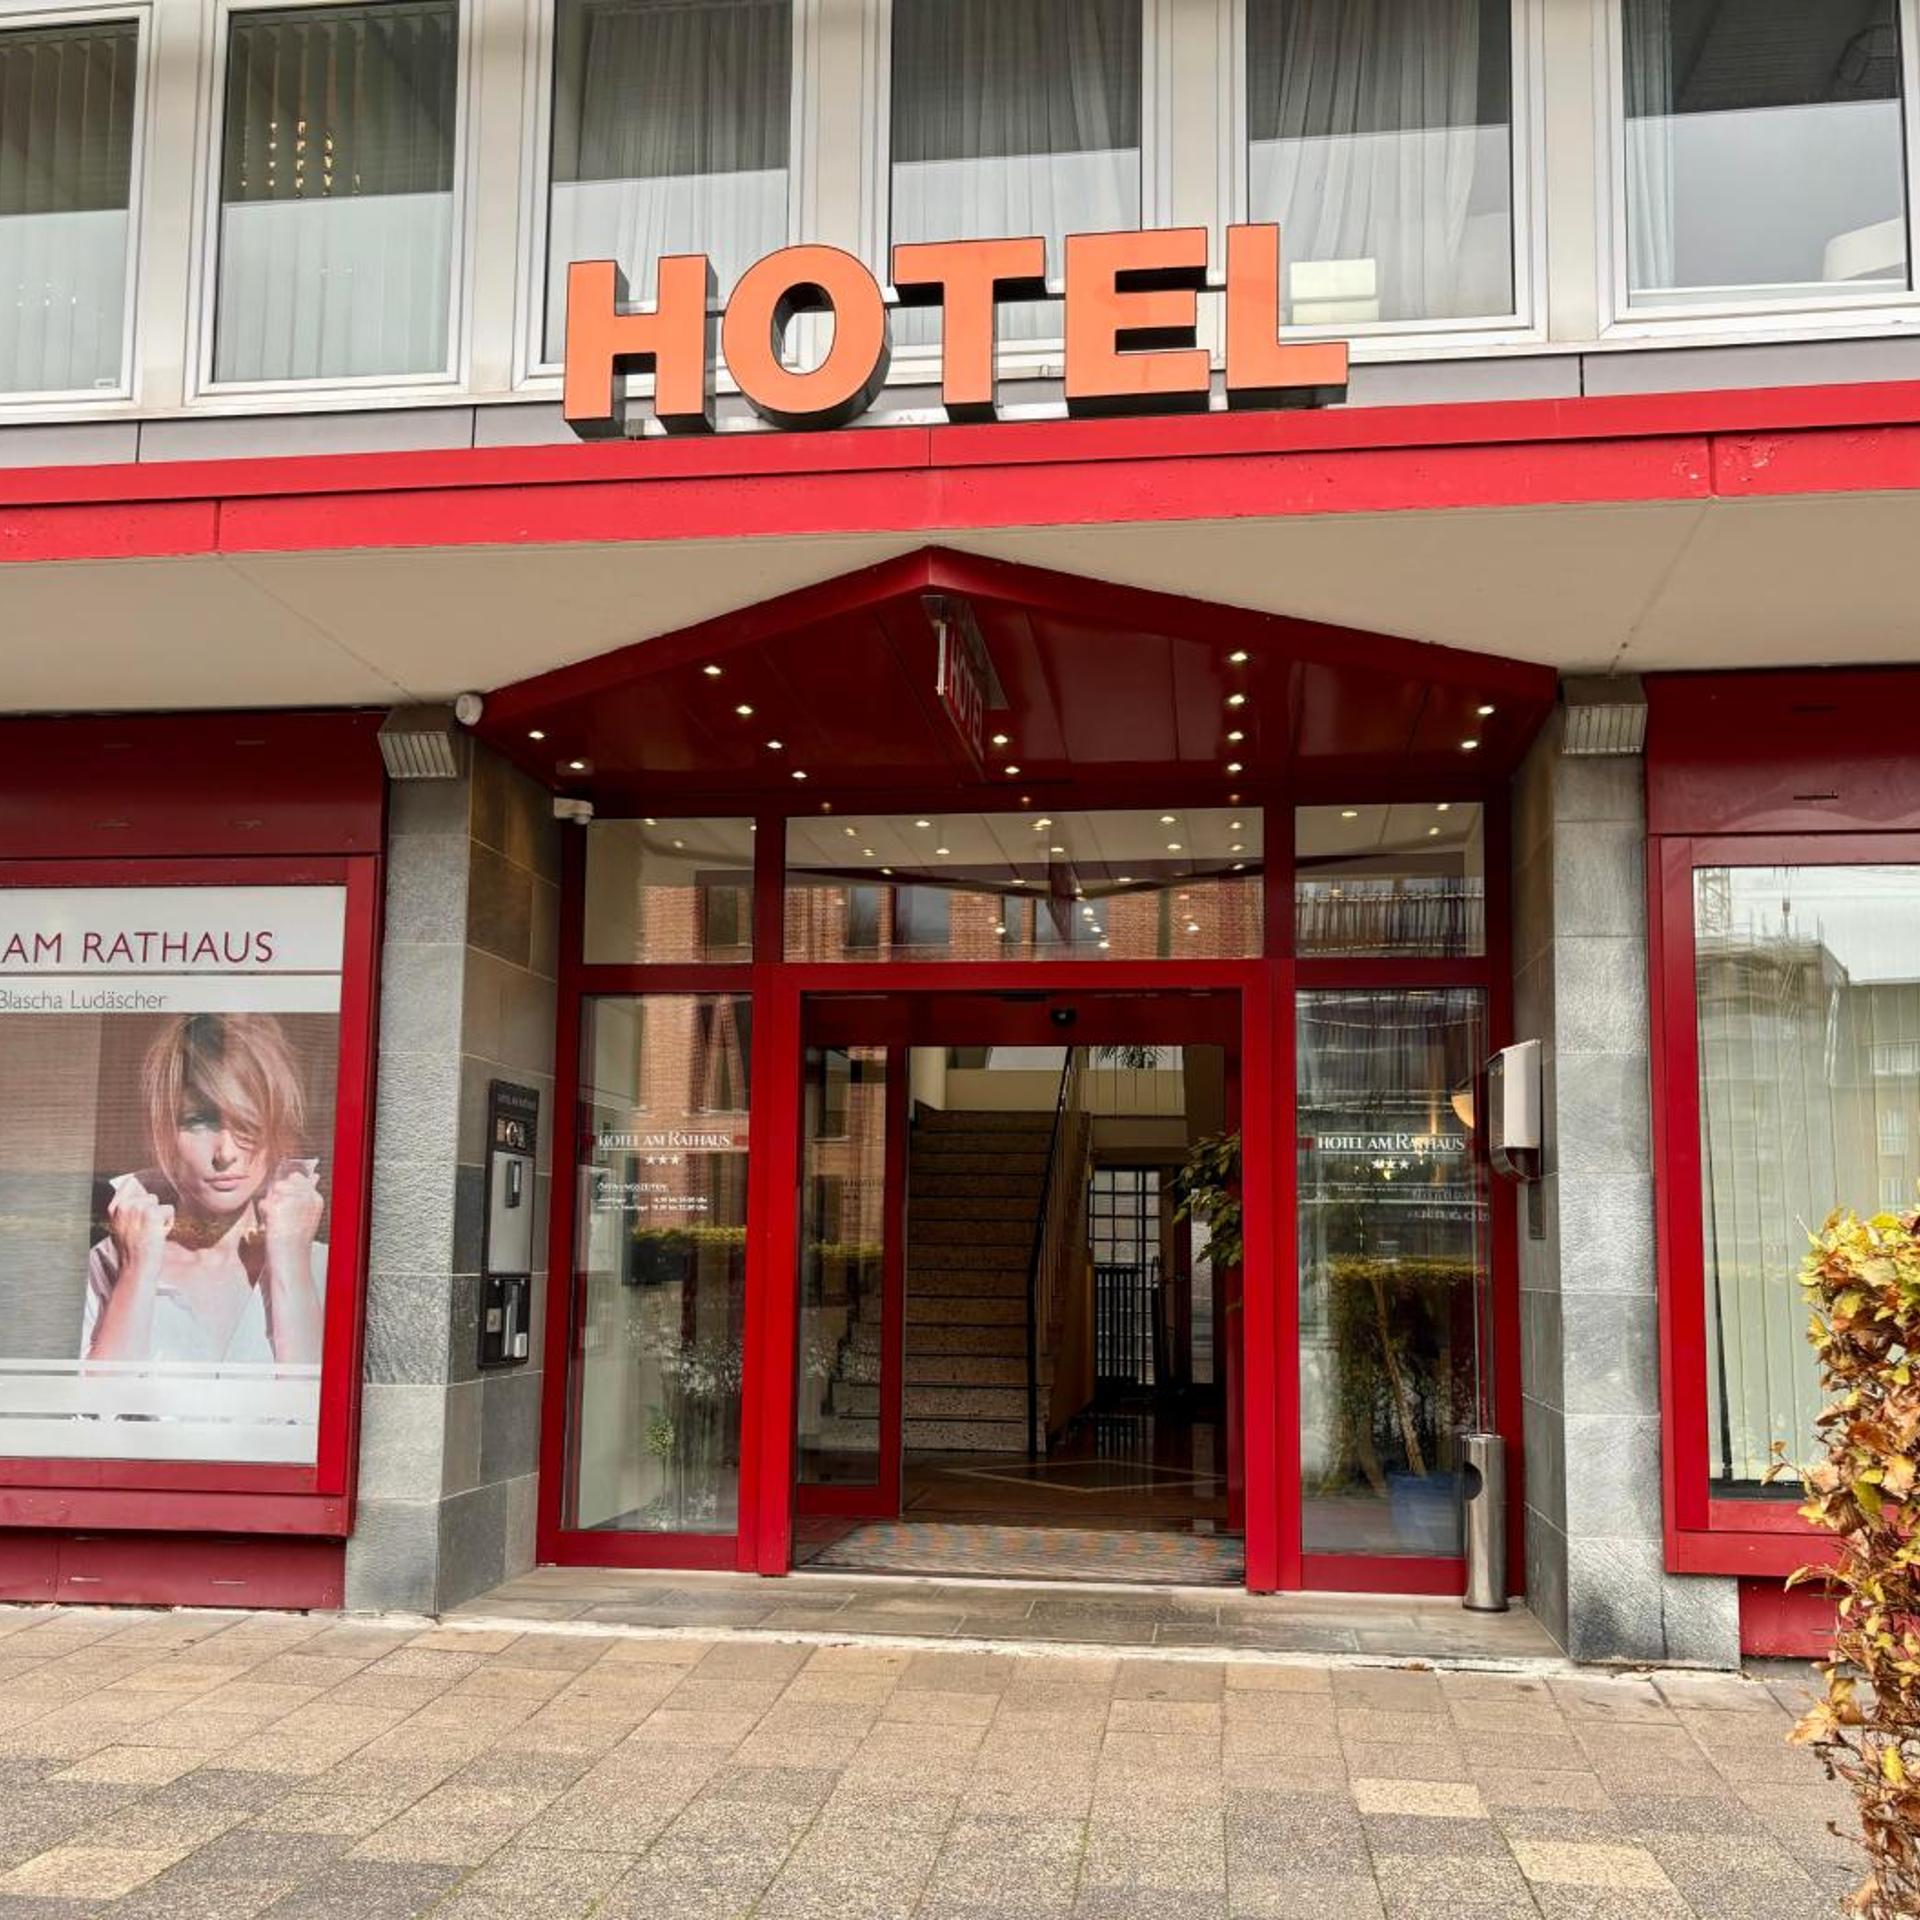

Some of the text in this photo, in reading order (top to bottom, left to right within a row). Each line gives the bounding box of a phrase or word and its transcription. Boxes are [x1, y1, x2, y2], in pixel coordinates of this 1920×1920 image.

[564, 223, 1349, 442] HOTEL
[1, 931, 274, 963] AM RATHAUS
[71, 990, 166, 1009] Ludäscher
[1318, 1136, 1364, 1150] HOTEL
[1367, 1137, 1392, 1150] AM
